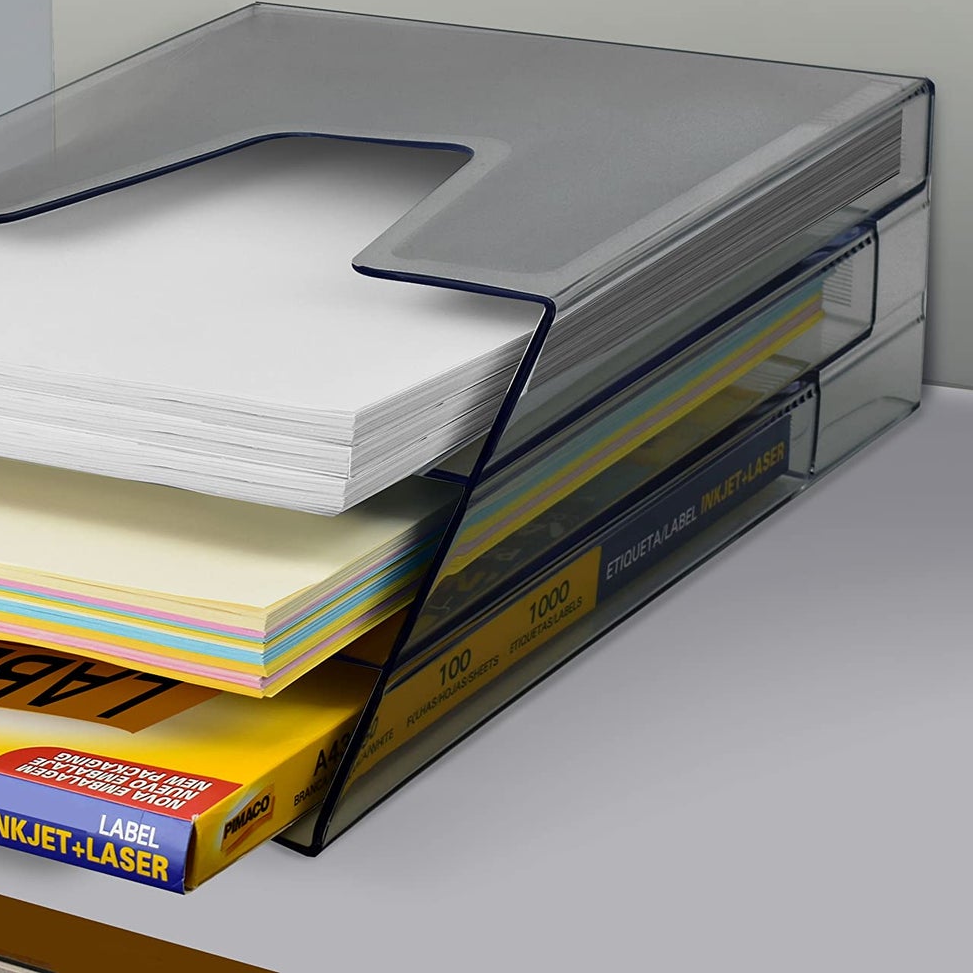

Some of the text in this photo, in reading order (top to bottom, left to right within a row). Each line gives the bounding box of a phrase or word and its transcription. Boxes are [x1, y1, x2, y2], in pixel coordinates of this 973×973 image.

[606, 441, 785, 580] ETIQUETA/LABEL INKJET+LASER
[530, 579, 570, 624] 1000
[439, 648, 472, 686] 100
[15, 764, 187, 810] NOVA EMBALAGEM
[29, 756, 201, 801] NUEVO EMBALAJE
[54, 751, 213, 791] NEW PACKAGING
[98, 814, 160, 849] LABEL
[223, 794, 271, 840] PIMACO
